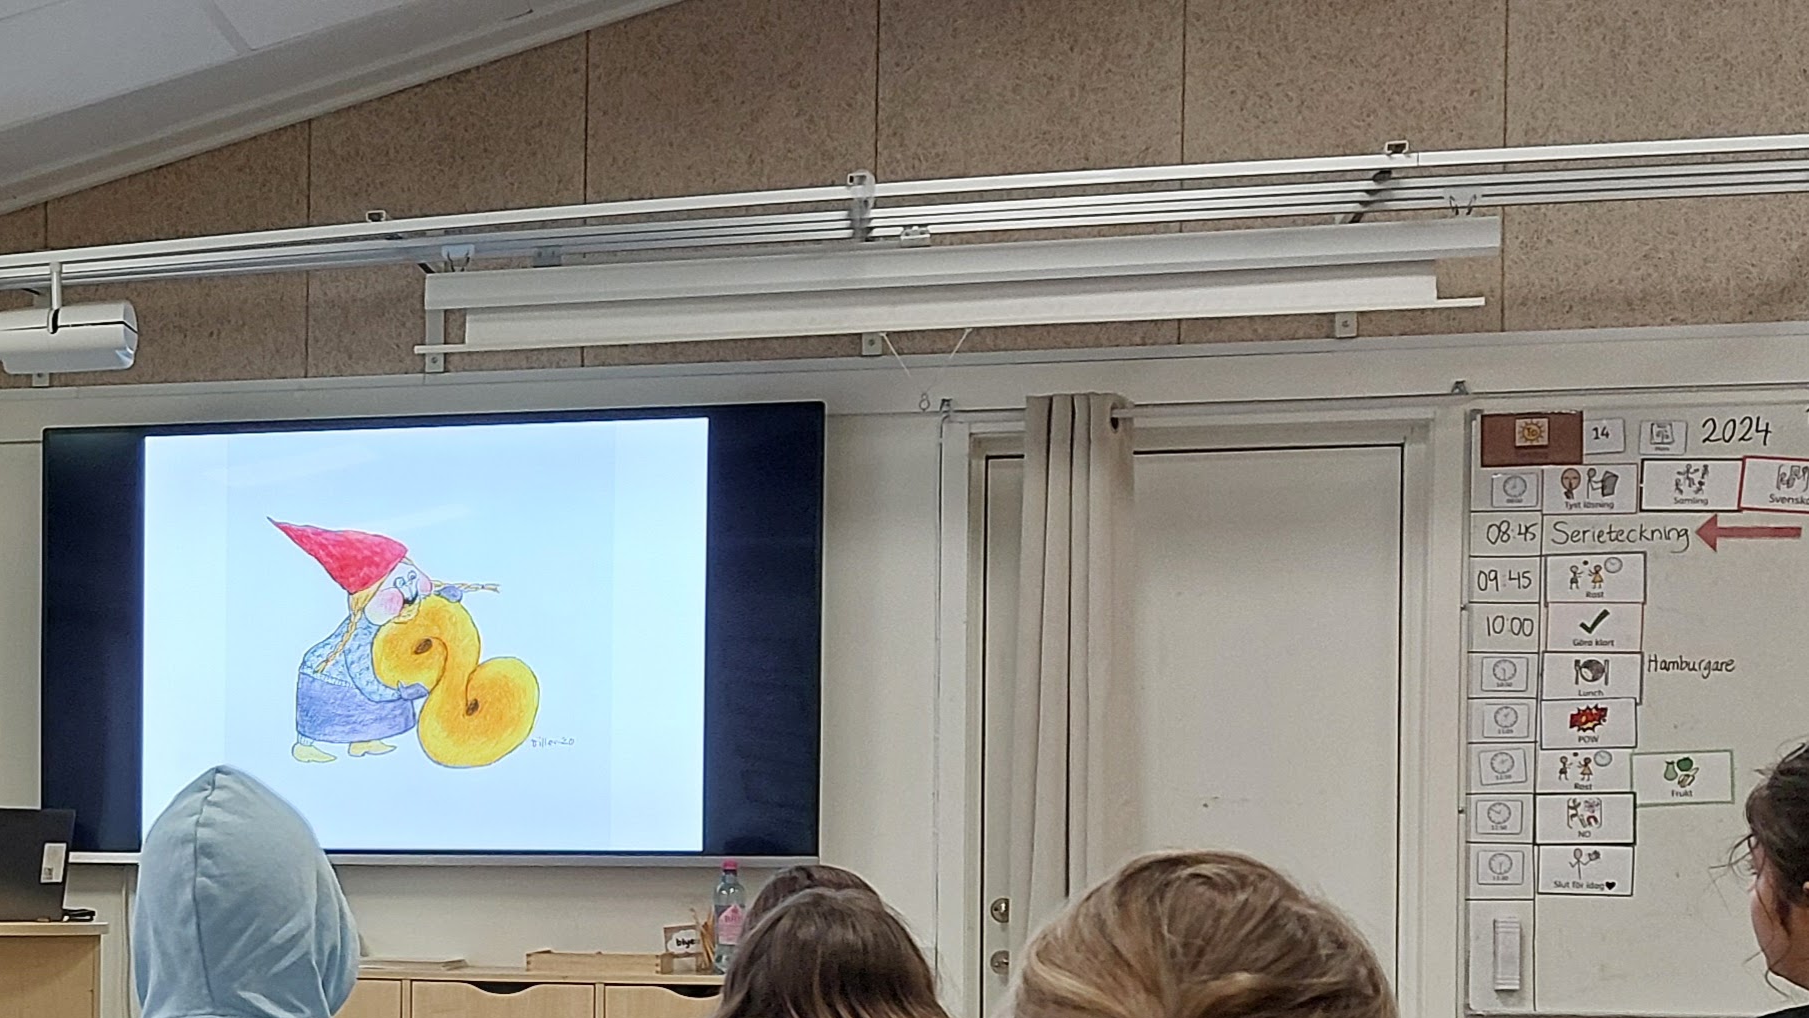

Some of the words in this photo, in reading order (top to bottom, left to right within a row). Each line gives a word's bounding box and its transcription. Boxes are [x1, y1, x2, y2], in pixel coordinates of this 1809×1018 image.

[1591, 426, 1610, 440] 14
[1701, 415, 1772, 446] 2024
[1673, 497, 1709, 506] Samling
[1486, 520, 1539, 545] 08:45
[1551, 520, 1690, 554] Serieteckning
[1477, 569, 1532, 592] 09:45
[1486, 615, 1534, 637] 10:00
[1647, 653, 1736, 680] Hamburgare
[1577, 689, 1605, 697] Lunch
[1577, 735, 1600, 743] POW
[1573, 782, 1593, 790] Rast
[1671, 789, 1694, 797] Frukt
[1577, 830, 1592, 838] NO
